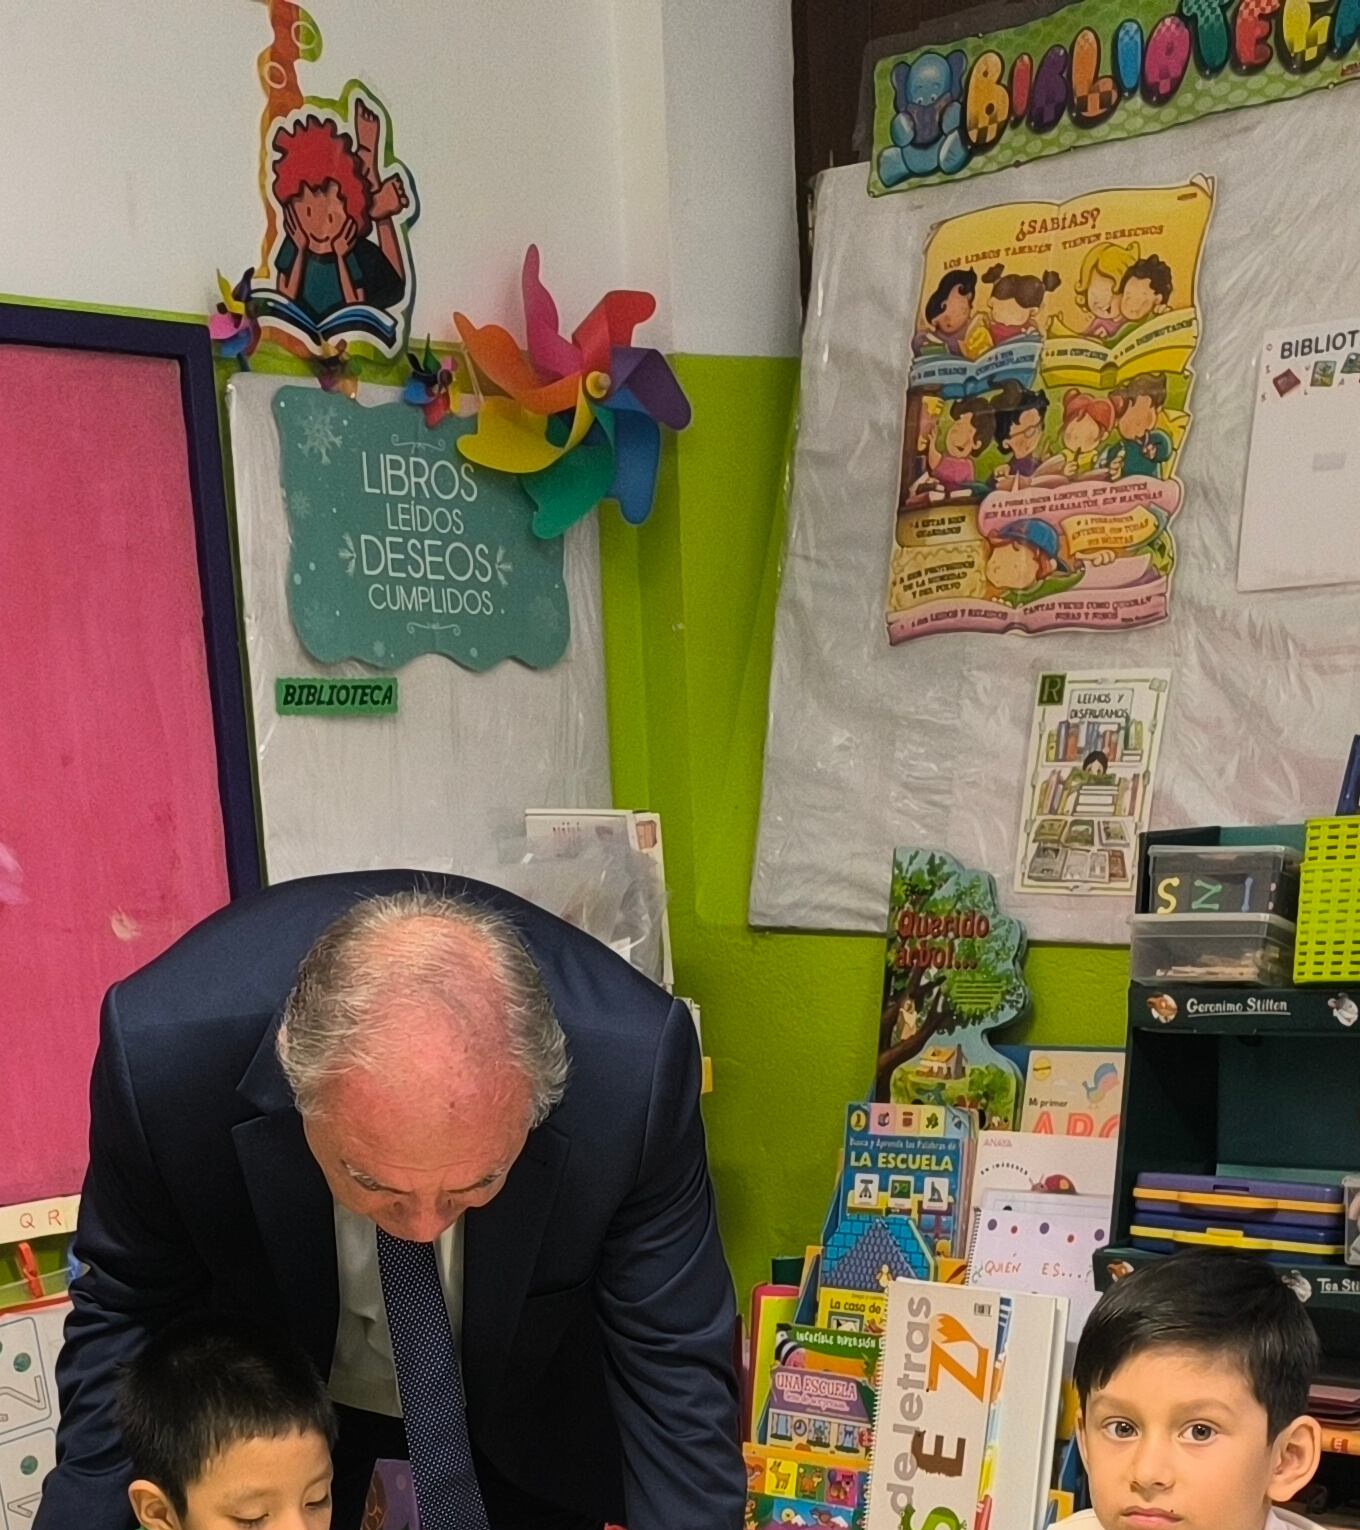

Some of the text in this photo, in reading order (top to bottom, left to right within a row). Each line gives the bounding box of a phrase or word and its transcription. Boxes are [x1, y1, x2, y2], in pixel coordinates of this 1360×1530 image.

[964, 248, 1001, 266] LIBROS
[1104, 224, 1165, 242] DERECHOS
[362, 451, 478, 502] LIBROS
[386, 500, 465, 535] LEÍDOS
[360, 534, 492, 583] DESEOS
[368, 583, 494, 615] CUMPLIDOS
[282, 684, 393, 707] BIBLIOTECA
[1076, 692, 1124, 705] LEEMOS Y
[1069, 708, 1131, 720] DISFRUTAMOS
[896, 909, 990, 939] Querido
[1187, 997, 1244, 1014] Geronimo
[1040, 1099, 1069, 1109] primer
[916, 1139, 947, 1151] Palabras
[983, 1137, 1013, 1148] ANAYA
[849, 1152, 954, 1173] LA ESCUELA
[19, 1211, 36, 1230] Q
[47, 1208, 62, 1227] R
[829, 1297, 841, 1310] La
[843, 1302, 866, 1313] casa
[868, 1303, 882, 1315] de
[892, 1295, 932, 1436] letras
[775, 1372, 858, 1400] UNA ESCUELA
